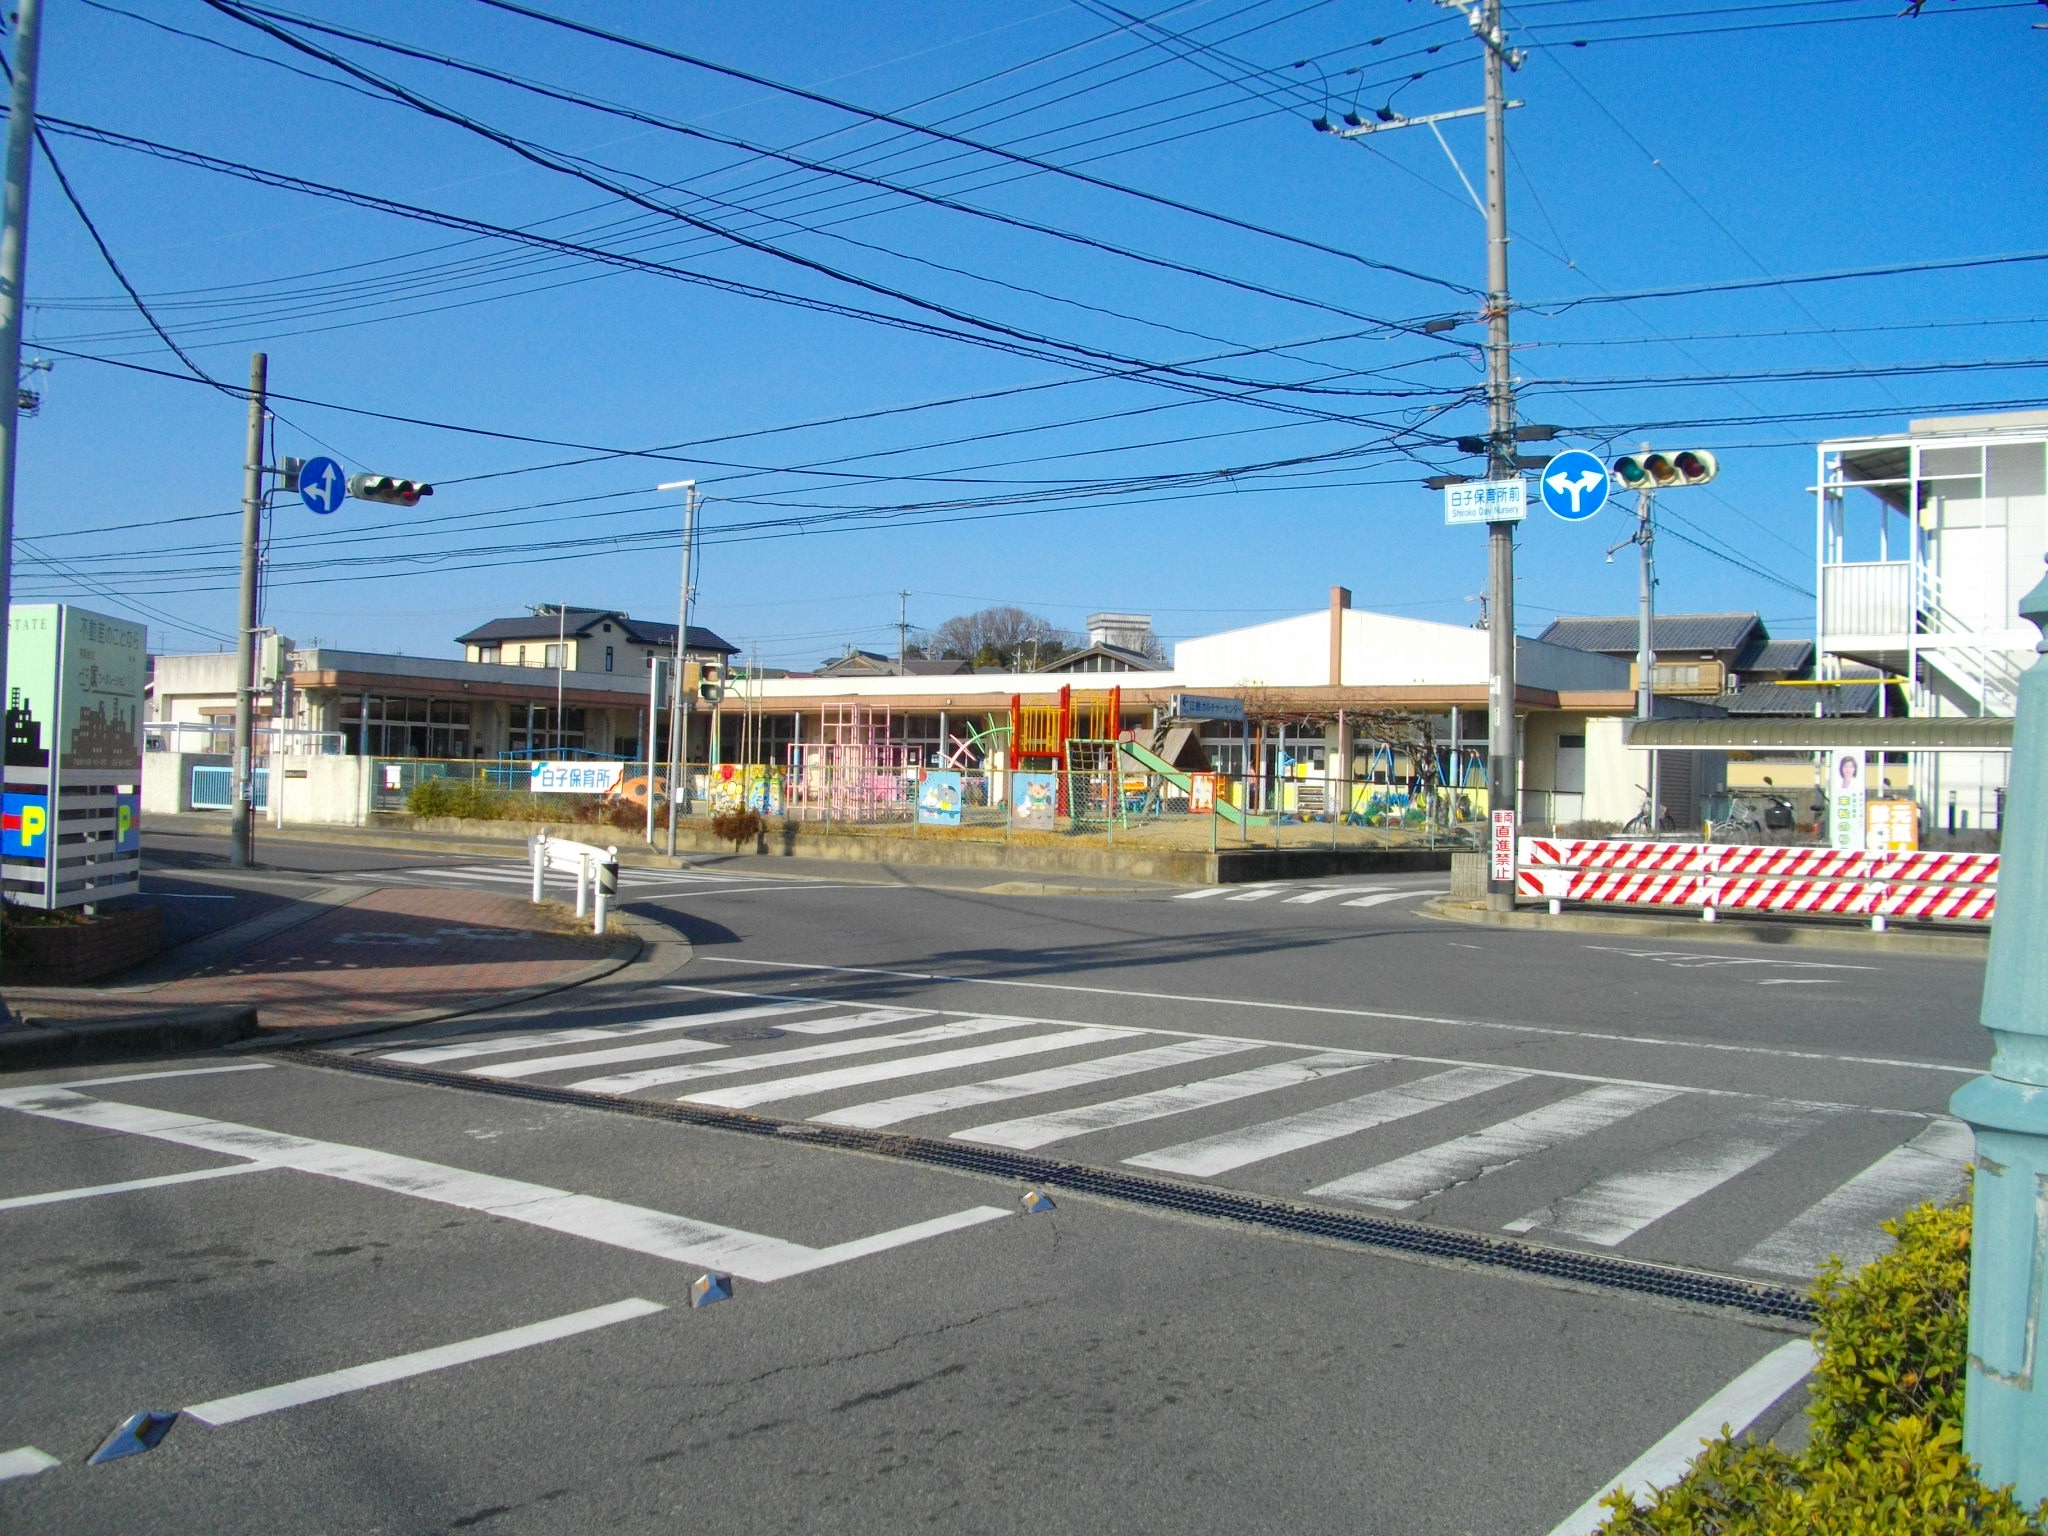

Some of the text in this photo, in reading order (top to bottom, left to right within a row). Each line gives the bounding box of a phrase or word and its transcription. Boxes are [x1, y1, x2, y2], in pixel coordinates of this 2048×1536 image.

[1451, 486, 1519, 507] 白子保育所前
[1453, 505, 1519, 518] Shiroko Day Nursery
[79, 617, 139, 650] 不動産のことなら
[542, 768, 611, 788] 白子保育所
[20, 805, 46, 847] P
[118, 804, 131, 843] P
[1494, 811, 1513, 825] 車両
[1495, 825, 1511, 880] 直進禁止
